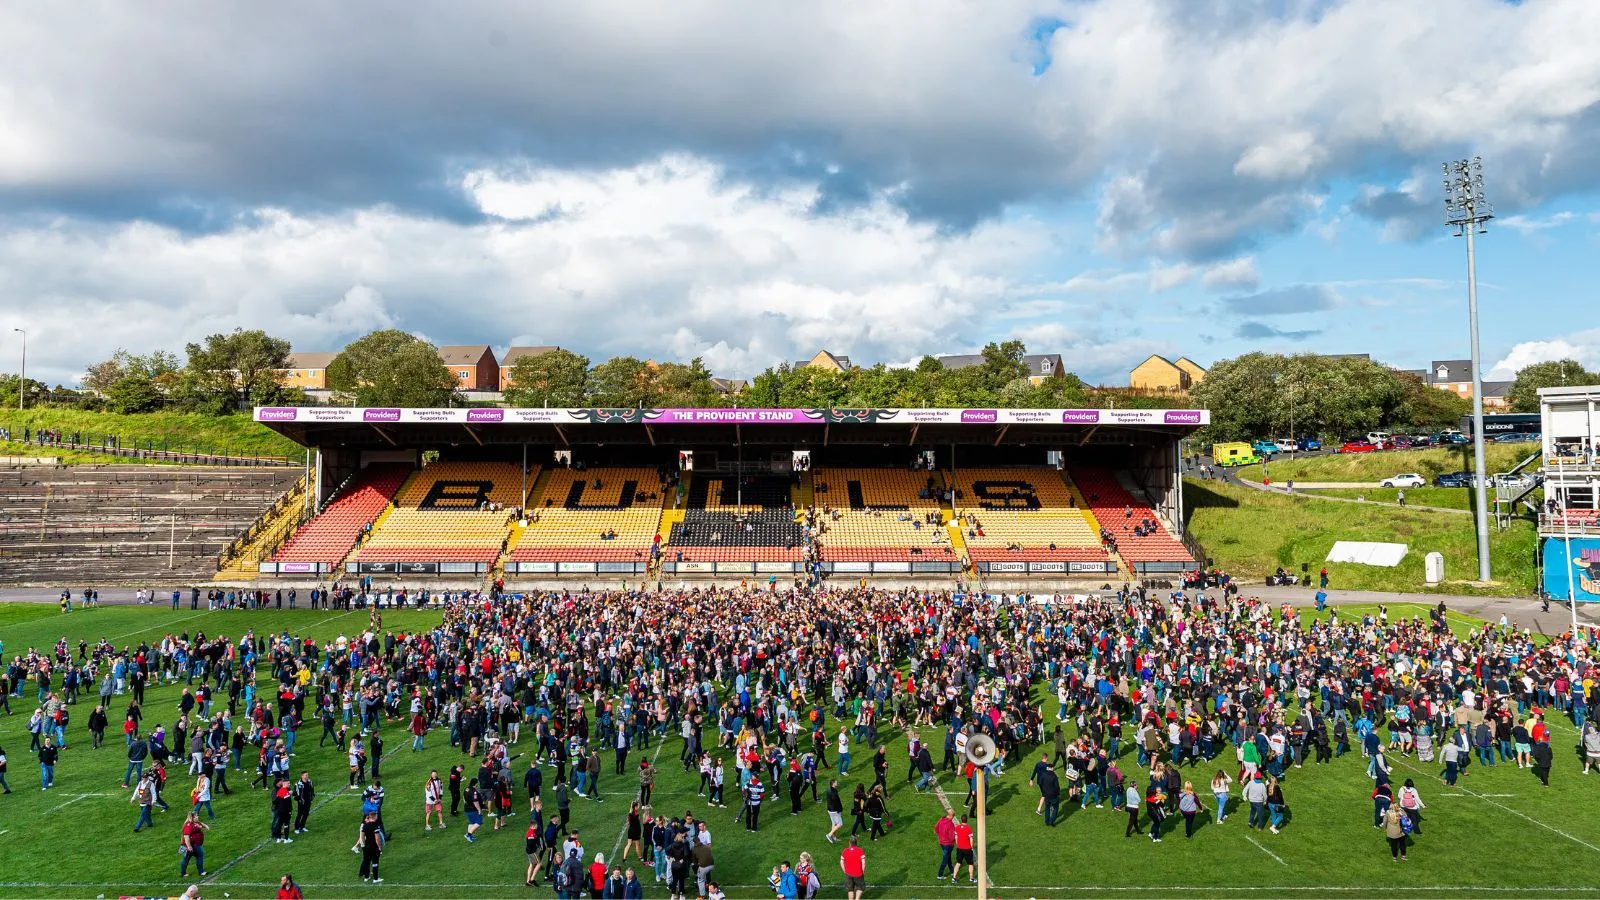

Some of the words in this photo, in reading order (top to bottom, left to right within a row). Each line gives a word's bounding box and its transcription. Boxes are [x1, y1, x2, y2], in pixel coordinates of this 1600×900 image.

[261, 411, 295, 419] Provident
[365, 411, 399, 419] Provident
[672, 411, 693, 420] THE
[696, 411, 756, 420] PROVIDENT
[759, 411, 794, 420] STAND
